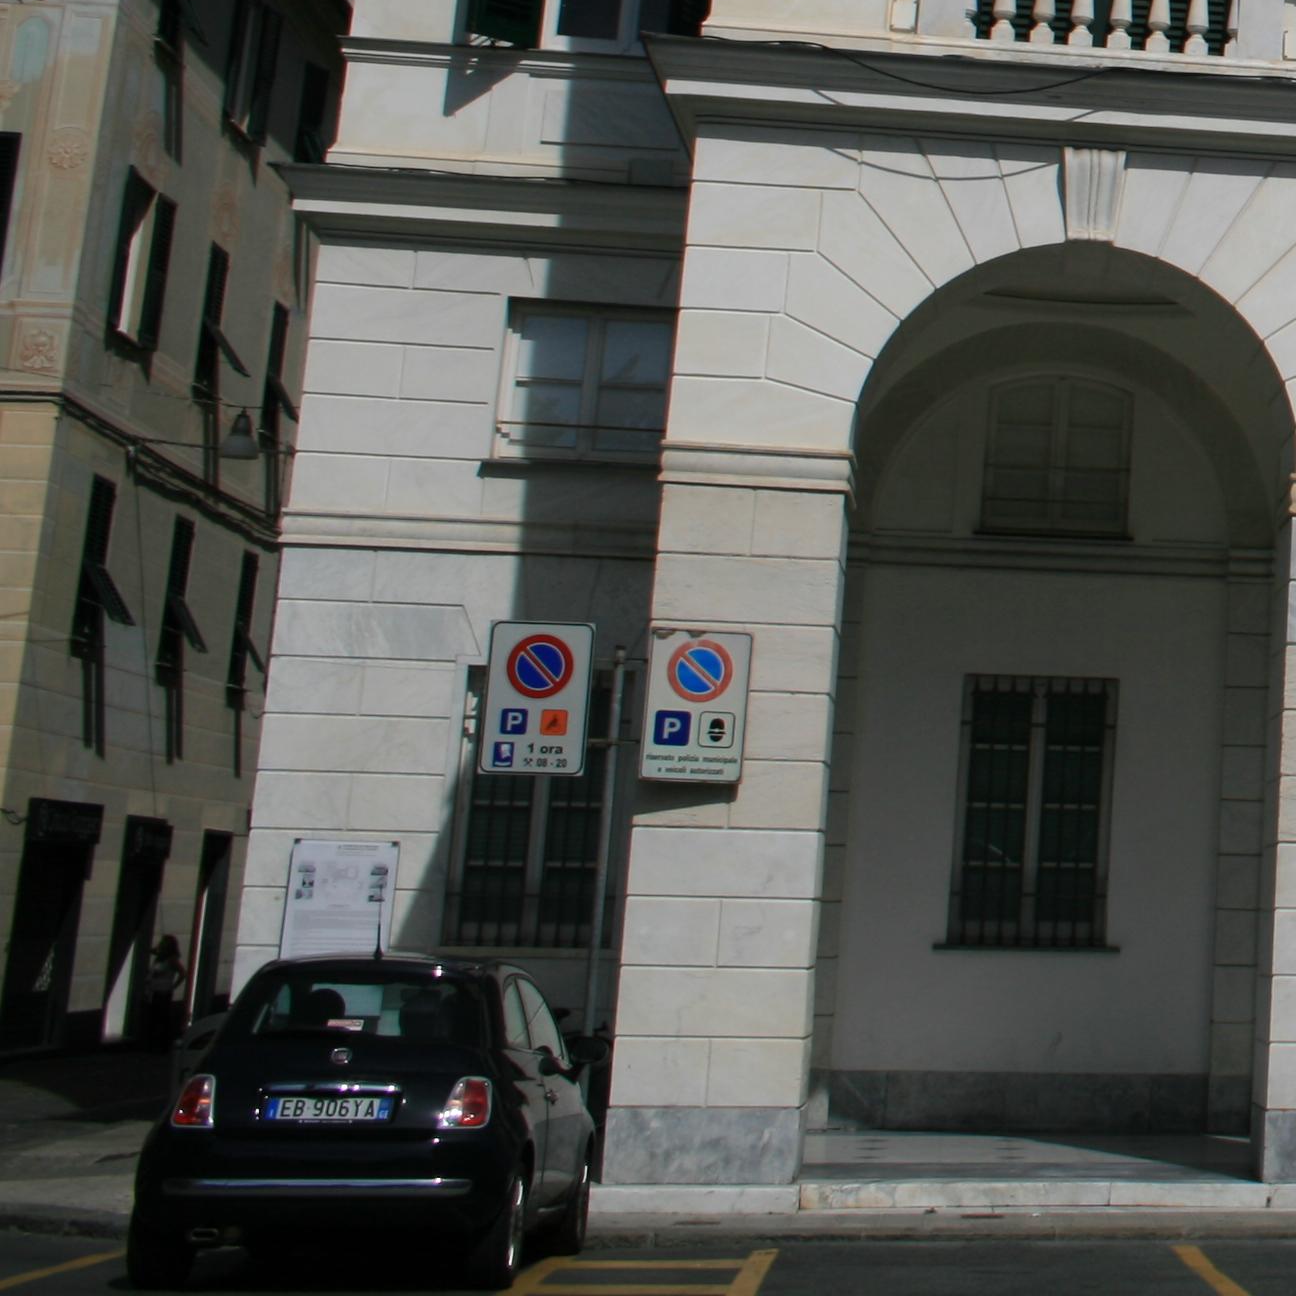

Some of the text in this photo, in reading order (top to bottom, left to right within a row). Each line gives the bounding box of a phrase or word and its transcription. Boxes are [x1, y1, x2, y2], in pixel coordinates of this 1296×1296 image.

[506, 711, 523, 732] P
[662, 717, 682, 740] P
[527, 742, 564, 755] 1 ora
[555, 758, 568, 769] 20
[678, 753, 700, 762] polizia
